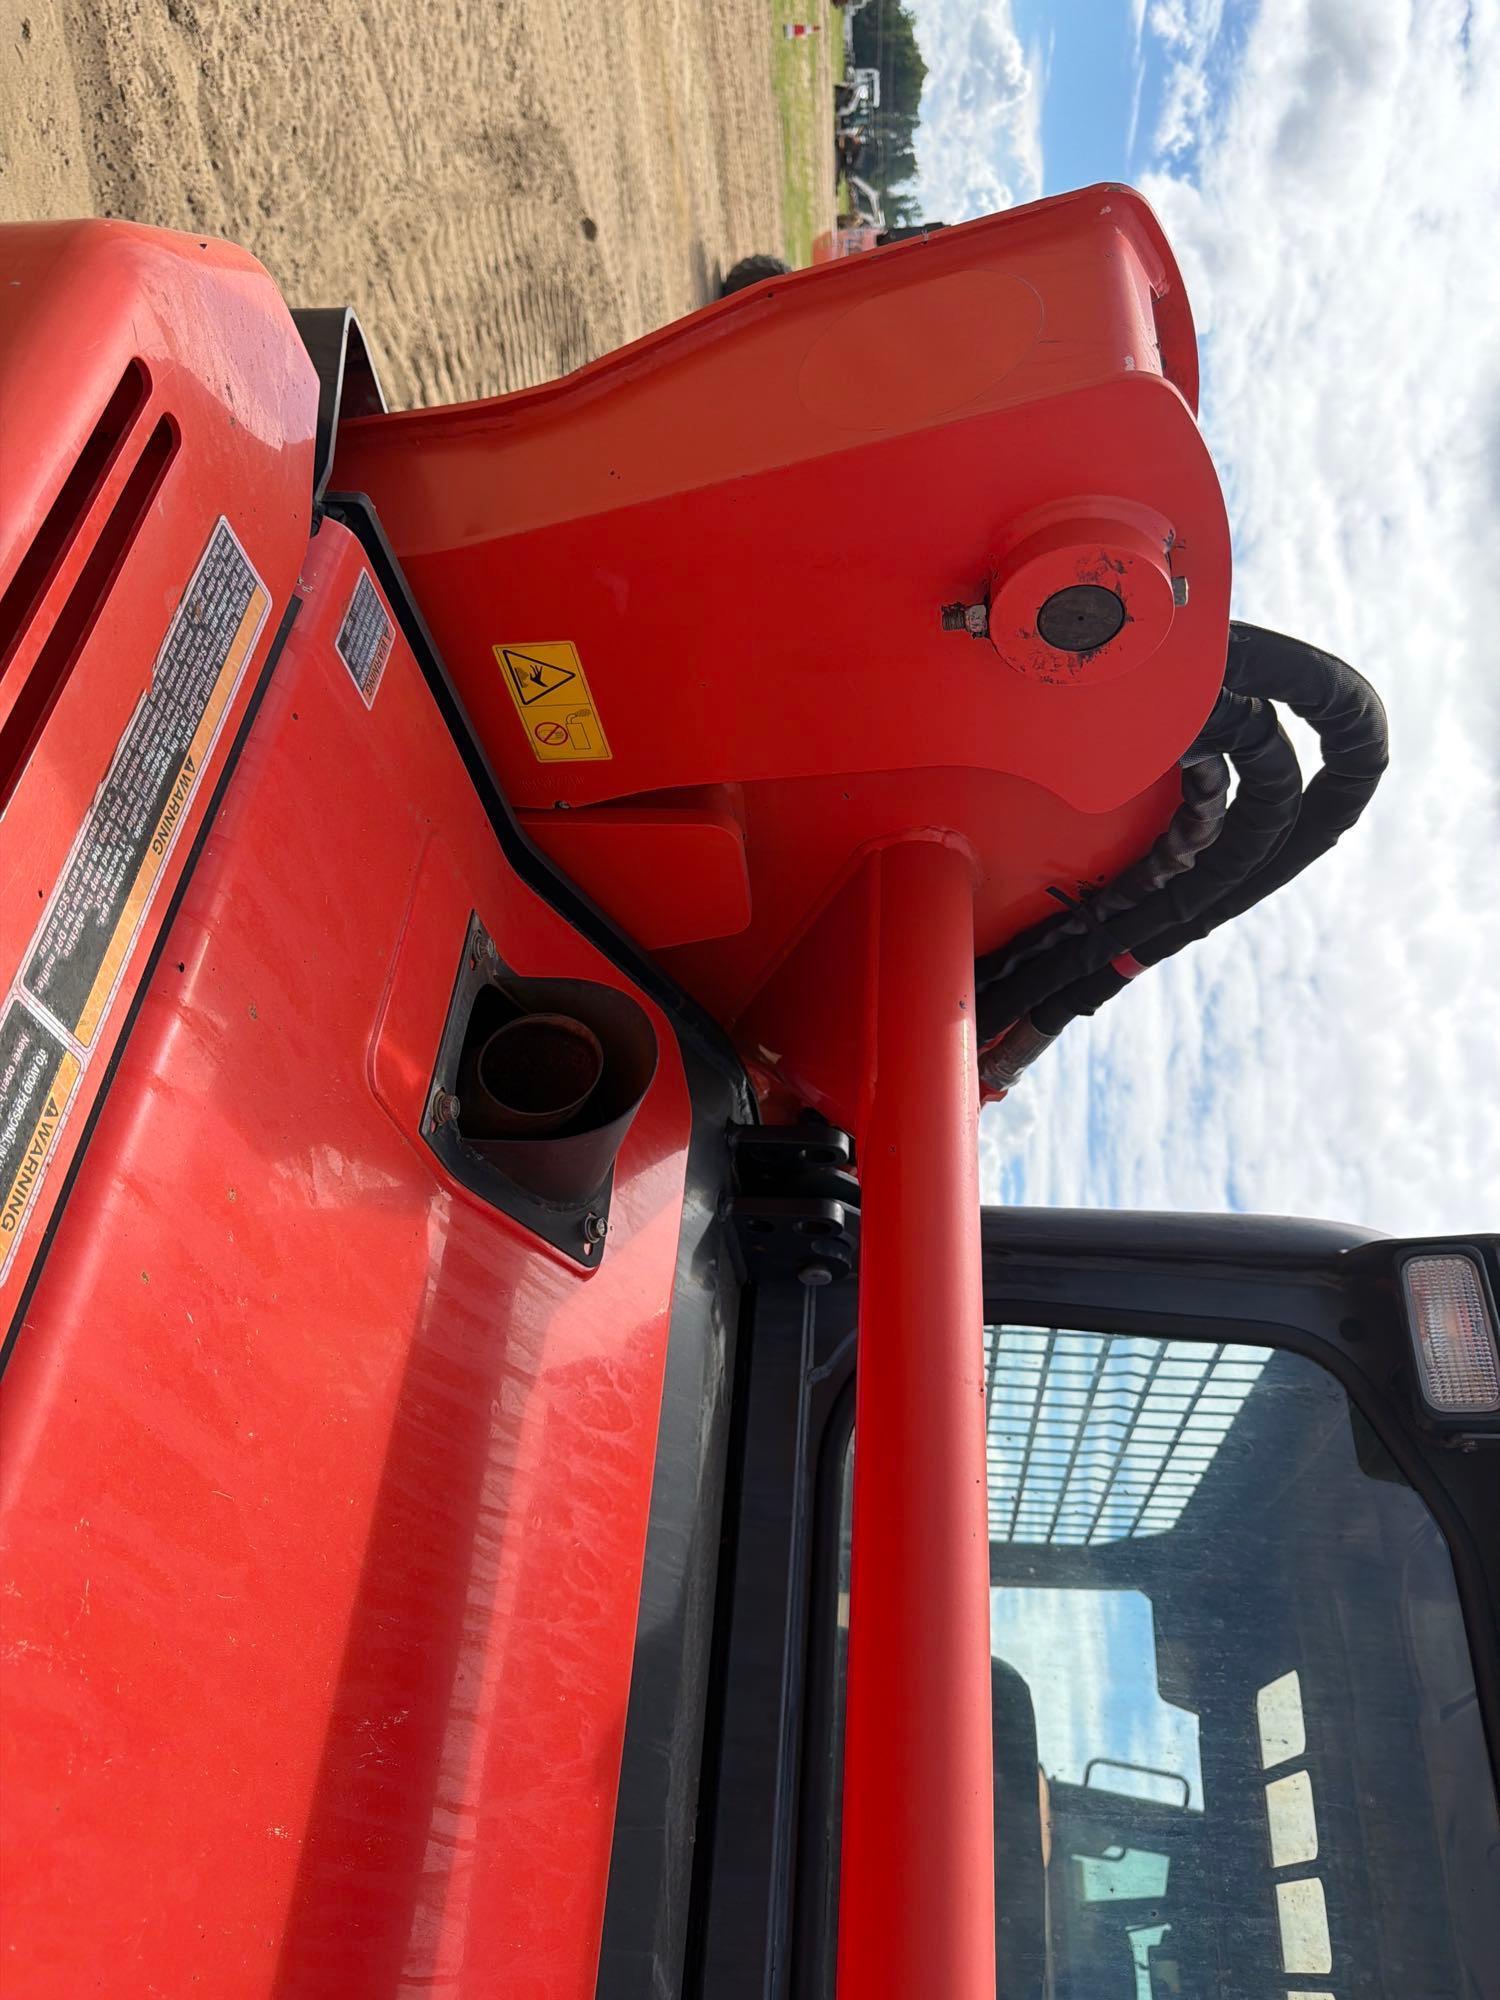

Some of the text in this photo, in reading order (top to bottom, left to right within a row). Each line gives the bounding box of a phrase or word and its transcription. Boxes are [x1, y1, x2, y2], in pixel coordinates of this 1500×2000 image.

[217, 528, 226, 547] and
[220, 536, 231, 558] away
[211, 543, 220, 560] the
[223, 547, 238, 578] During
[203, 557, 214, 578] SCR
[213, 557, 224, 579] from
[235, 558, 243, 574] the
[191, 575, 206, 607] muffler
[204, 576, 216, 600] other
[228, 571, 238, 591] DPF
[237, 567, 249, 592] When
[246, 576, 254, 593] TO
[216, 587, 231, 619] muffler
[231, 588, 240, 606] the
[235, 588, 249, 619] AVOID
[209, 615, 219, 635] and
[221, 602, 234, 630] Diesel
[175, 617, 188, 643] clean
[193, 628, 204, 649] take
[203, 631, 212, 649] the
[215, 615, 238, 667] PERSONAL
[168, 639, 178, 660] and
[186, 646, 197, 667] into
[203, 627, 224, 673] Particulate
[157, 655, 170, 680] away
[365, 637, 387, 697] WARNING
[149, 679, 161, 703] from
[171, 663, 189, 701] account
[201, 663, 218, 702] INJURY
[157, 690, 168, 711] and
[163, 698, 175, 720] that
[194, 698, 204, 717] OR
[128, 700, 152, 750] flammable
[137, 707, 160, 756] flammable
[156, 716, 167, 735] the
[140, 732, 160, 773] mufflers
[169, 736, 178, 754] the
[132, 770, 144, 792] will
[139, 745, 165, 799] Reduction)
[143, 750, 171, 813] regenerating
[109, 795, 123, 821] Also
[126, 789, 136, 806] be
[116, 801, 129, 827] very
[126, 796, 143, 833] muffler
[151, 769, 191, 857] WARNING
[97, 817, 113, 846] keep
[109, 825, 121, 847] hot
[131, 810, 147, 843] mode,
[75, 818, 100, 869] equipped
[91, 843, 102, 863] the
[101, 844, 113, 867] and
[123, 844, 134, 864] the
[66, 867, 80, 893] with
[81, 860, 94, 885] area
[88, 863, 104, 893] keep
[102, 848, 122, 889] become
[107, 861, 127, 904] exhaust
[55, 891, 70, 919] SCR
[71, 884, 84, 910] near
[82, 891, 93, 912] the
[63, 908, 74, 930] the
[52, 928, 66, 956] DPF
[62, 910, 85, 959] machine
[0, 1034, 29, 1093] Never open
[22, 1063, 41, 1095] AVOID
[1, 1091, 29, 1146] PERSONAL
[0, 1118, 53, 1234] WARNING
